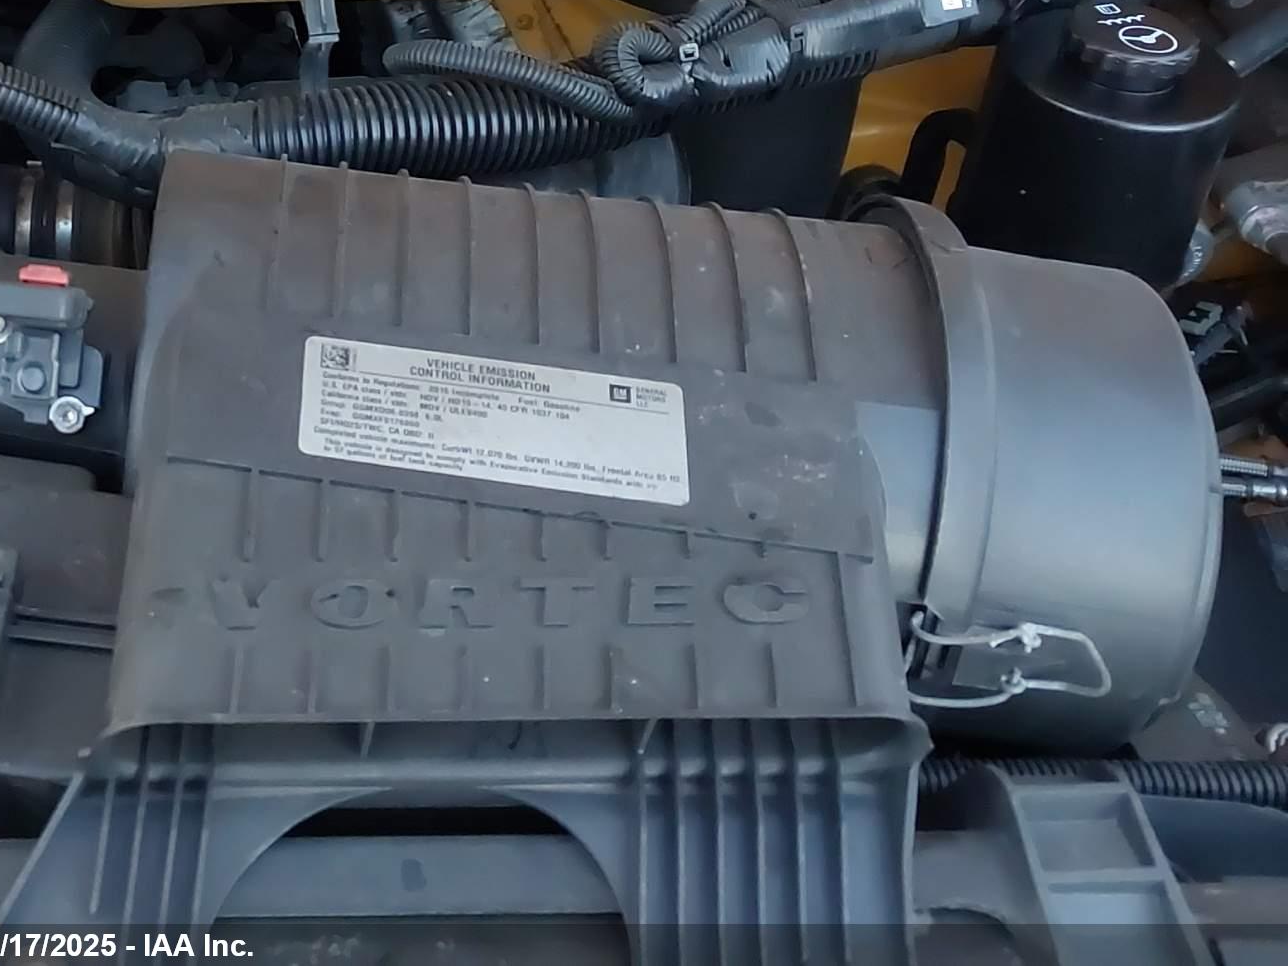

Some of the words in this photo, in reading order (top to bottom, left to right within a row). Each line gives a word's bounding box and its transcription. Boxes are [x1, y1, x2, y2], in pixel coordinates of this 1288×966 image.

[410, 365, 463, 381] CONTROL
[469, 373, 550, 393] INFORMATION
[426, 357, 473, 372] VEHICLE
[479, 364, 535, 381] EMISSION
[211, 575, 810, 631] VORTEC
